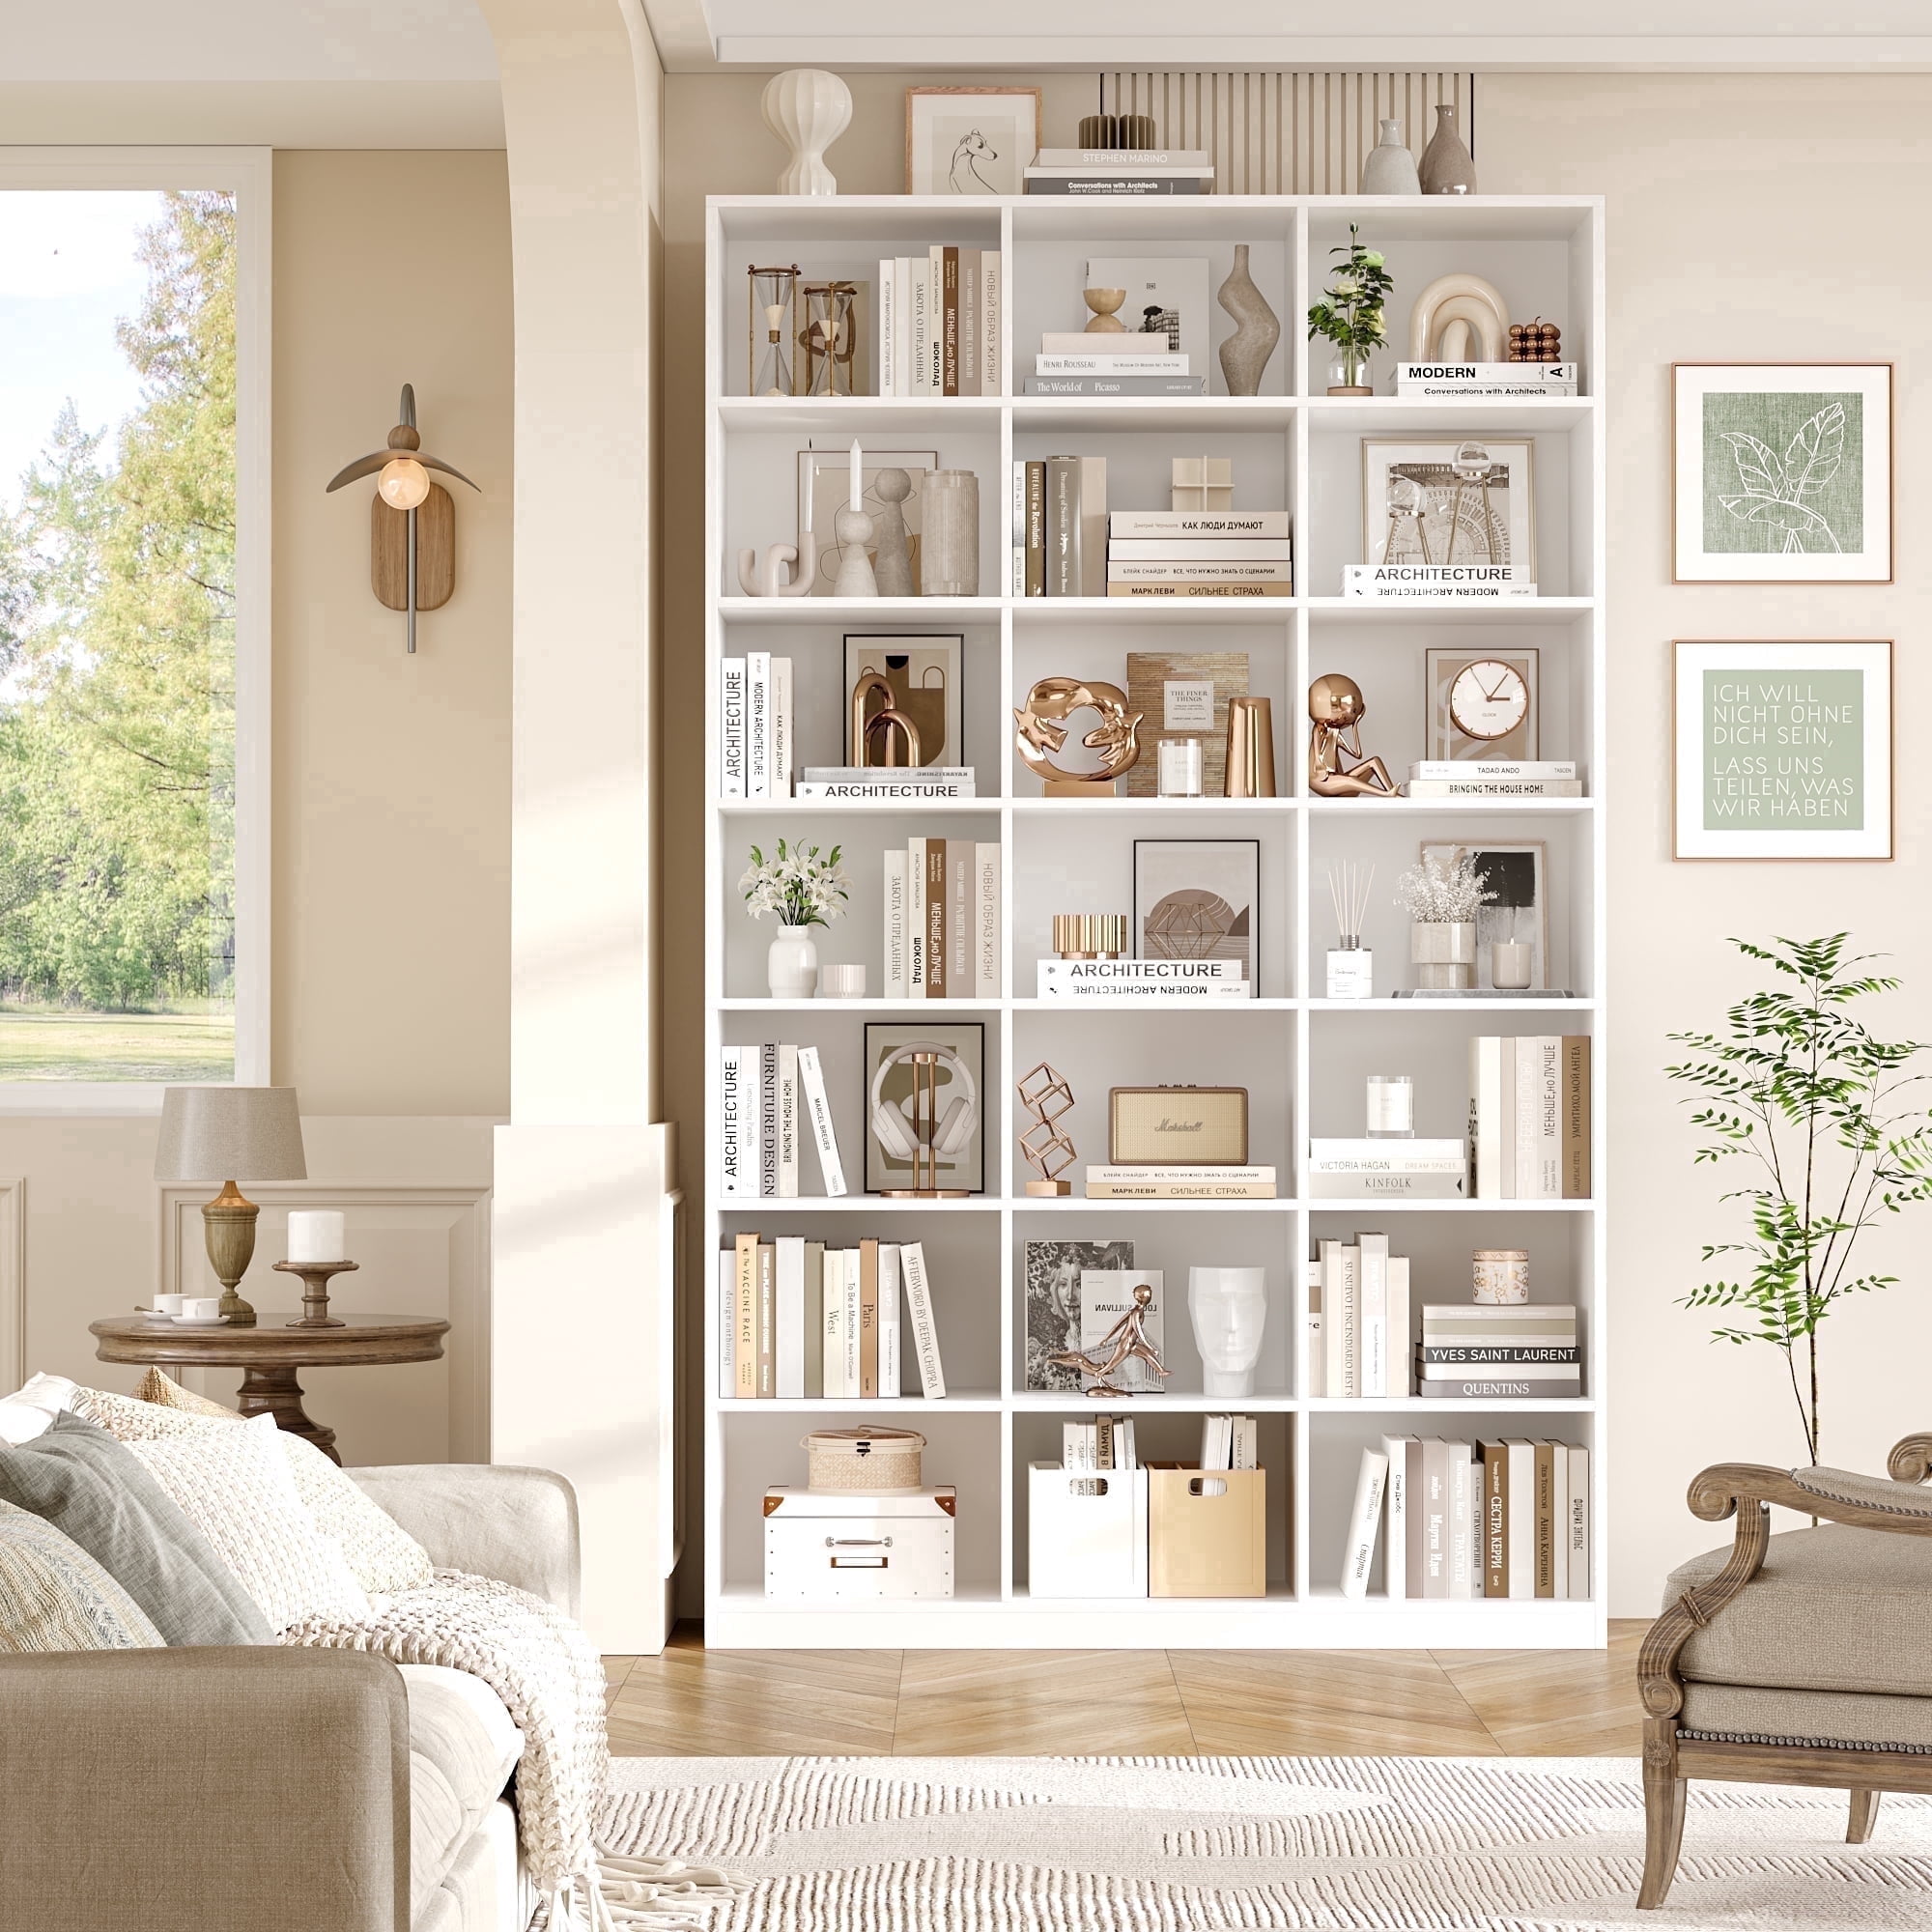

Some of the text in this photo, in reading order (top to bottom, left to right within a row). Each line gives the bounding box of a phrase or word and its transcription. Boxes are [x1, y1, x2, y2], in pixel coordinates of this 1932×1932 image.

[1083, 154, 1167, 162] STEPHEN MARINO
[987, 270, 997, 383] НОВЫЙ ОБРАЗ ЖИЗНИ
[916, 327, 924, 384] ПРЕДАННЫХ
[1043, 360, 1096, 369] HENRI ROUSSEAU
[947, 357, 955, 387] ЛУЧШЕ
[1408, 367, 1476, 379] MODERN
[1549, 367, 1563, 378] A
[1037, 383, 1050, 392] The
[1051, 383, 1072, 392] World
[1094, 383, 1121, 392] Picasso
[1059, 471, 1068, 499] Dreaming
[1032, 511, 1040, 549] Revolution
[1182, 522, 1264, 530] КАК ЛЮДИ ДУМАЮТ
[1375, 568, 1512, 581] ARCHITECTURE
[753, 682, 763, 715] MODERN
[1714, 684, 1819, 702] ICH WILL
[726, 671, 741, 778] ARCHITECTURE
[1714, 705, 1853, 724] NICHT OHNE
[753, 717, 763, 776] ARCHITECTURE
[1714, 726, 1833, 748] DICH SEIN,
[1714, 756, 1824, 775] LASS UNS
[826, 785, 958, 797] ARCHITECTURE
[1449, 784, 1544, 794] BRINGING THE HOUSE HOME
[1713, 778, 1854, 799] TEILEN, WAS
[1712, 799, 1848, 816] WIR HABEN
[892, 875, 901, 910] ЗАБОТА
[983, 863, 995, 980] НОВЫЙ ОБРАЗ ЖИЗНИ
[892, 923, 901, 980] ПРЕДАННЫХ
[912, 937, 922, 983] ШОКОЛАД
[930, 954, 941, 985] ЛУЧШЕ
[1070, 964, 1222, 977] ARCHITECTURE
[1073, 985, 1208, 994] MODERN ARCHITECTURE
[1544, 1044, 1555, 1079] ЛУЧШЕ
[1572, 1046, 1581, 1072] АНГЕЛ
[724, 1061, 737, 1177] ARCHITECTURE
[764, 1043, 775, 1196] FURNITURE DESIGN
[783, 1078, 792, 1163] BRINGING THE HOUSE HOME
[813, 1098, 831, 1151] MARCEL BREUER
[1154, 1119, 1203, 1132] Marshall
[1320, 1161, 1390, 1170] VICTORIA HAGAN
[1365, 1178, 1412, 1188] KINFOLK
[1573, 1166, 1581, 1192] АНДРЕАС
[1345, 1261, 1352, 1272] SU
[847, 1283, 855, 1292] To
[847, 1292, 855, 1302] Be
[724, 1291, 734, 1320] design
[863, 1304, 874, 1329] Paris
[828, 1310, 838, 1334] West
[907, 1256, 939, 1389] AFTERWORD BY DEEPAK CHOPRA
[1431, 1349, 1576, 1361] YVES SAINT LAURENT
[1463, 1383, 1529, 1396] QUENTINS
[1574, 1498, 1583, 1525] ФРИДРИХ
[1491, 1496, 1502, 1569] СЕСТРА КЕРРИ
[1428, 1515, 1442, 1577] Мартин Иден
[1455, 1533, 1466, 1582] ТРАКТАТЫ
[1355, 1544, 1370, 1579] Спартак
